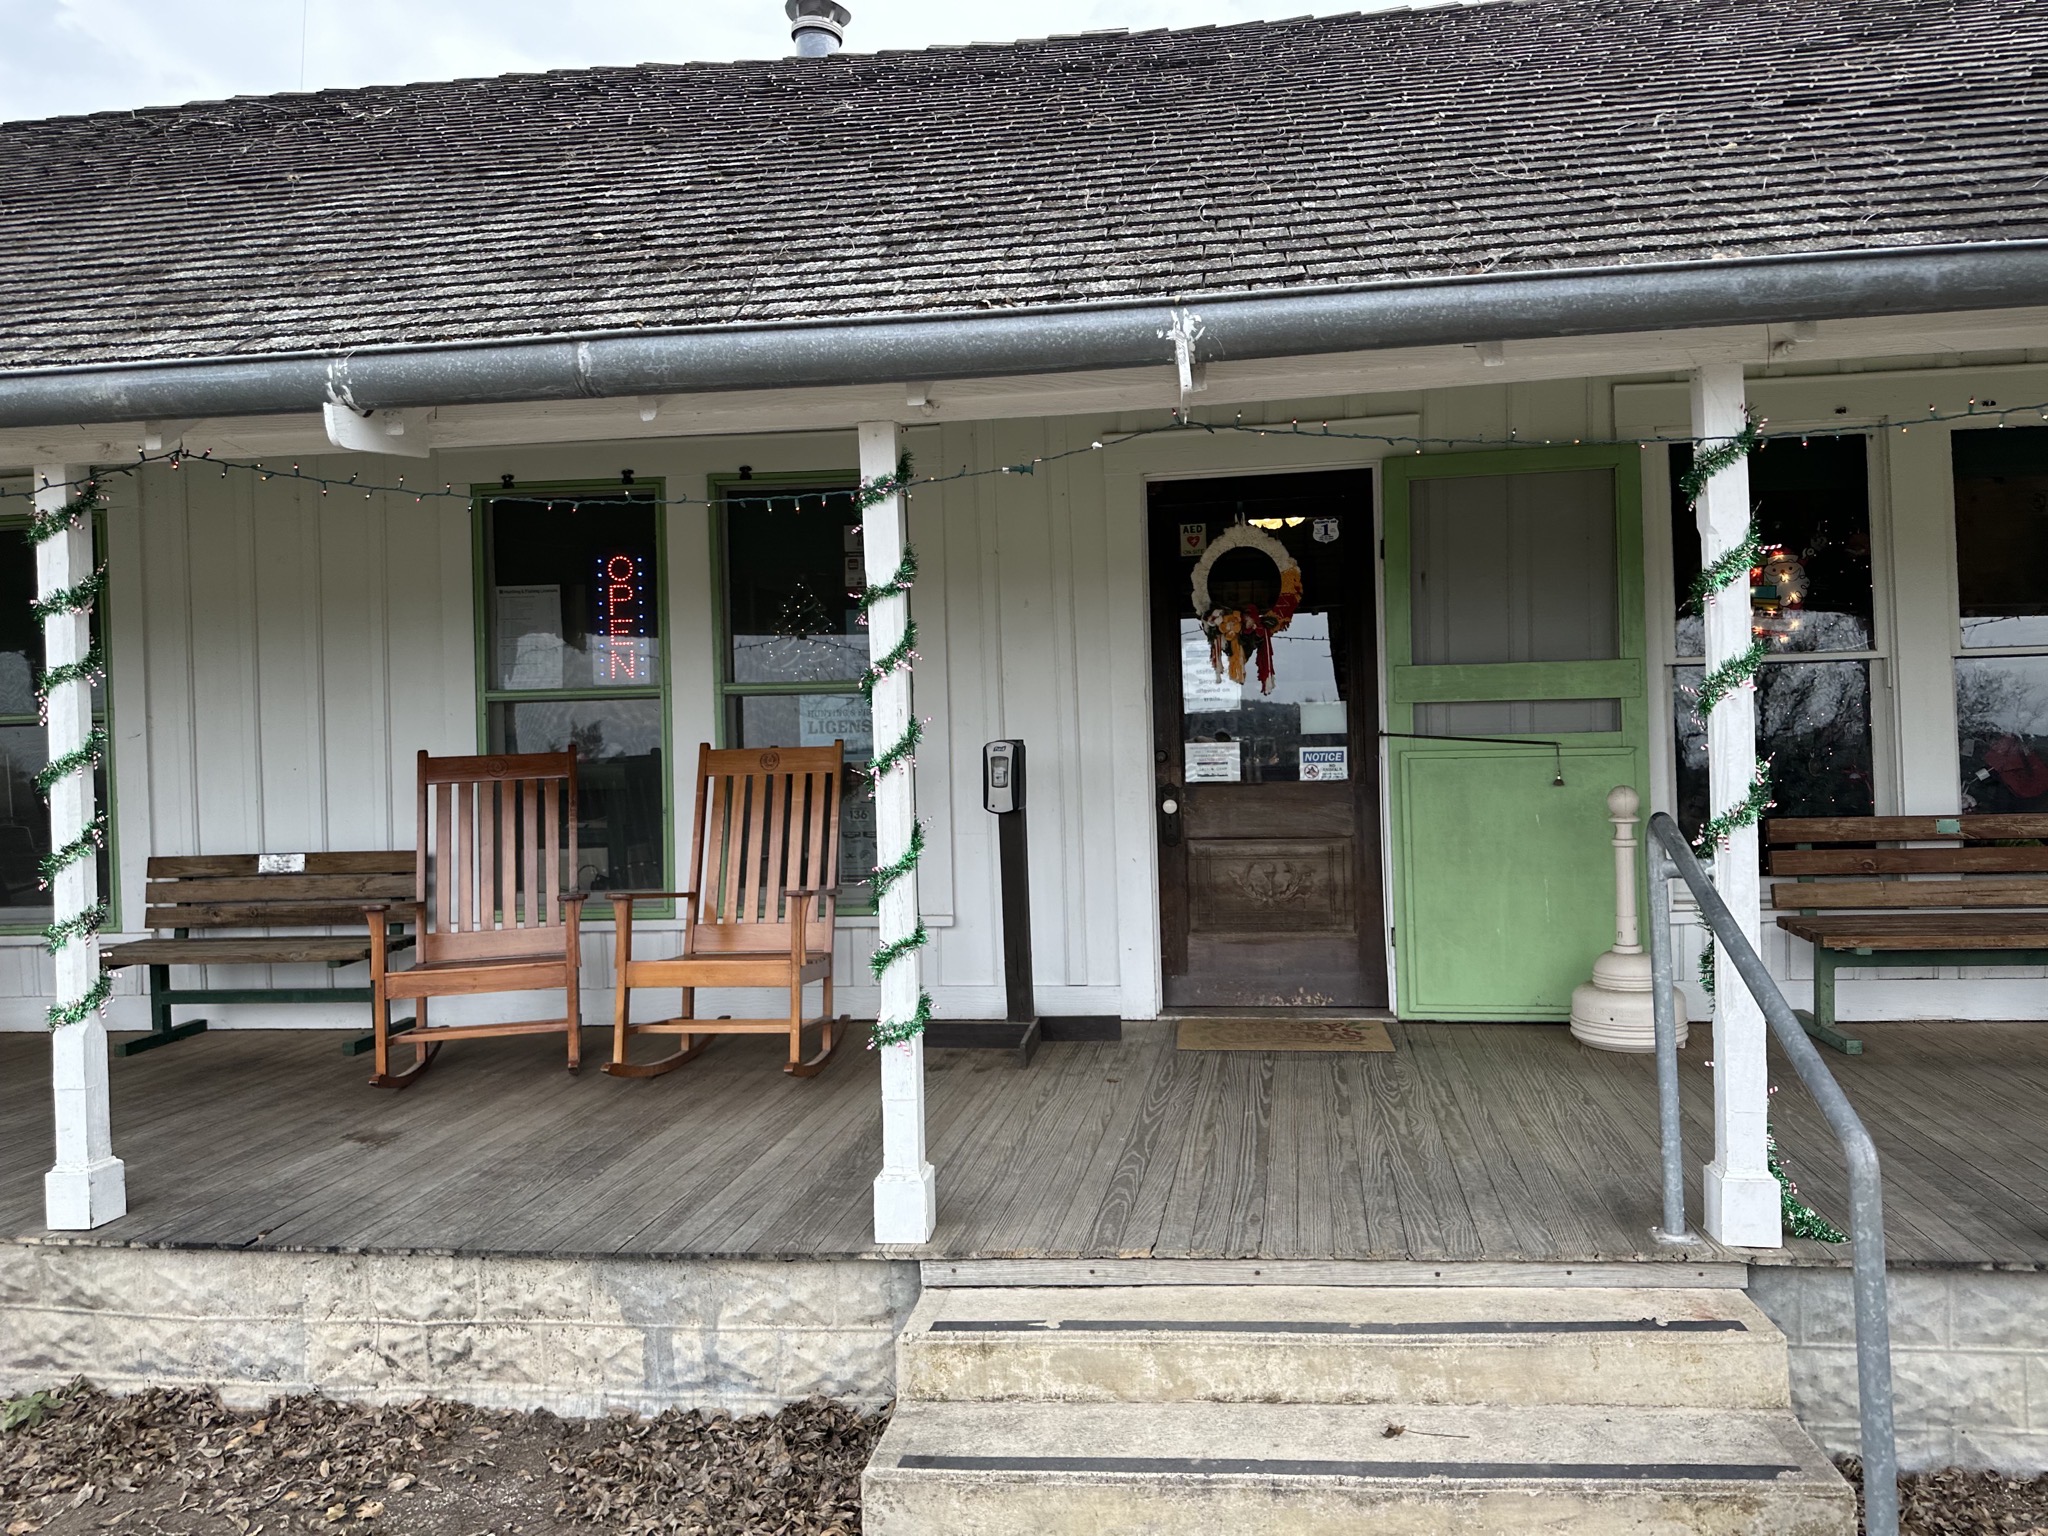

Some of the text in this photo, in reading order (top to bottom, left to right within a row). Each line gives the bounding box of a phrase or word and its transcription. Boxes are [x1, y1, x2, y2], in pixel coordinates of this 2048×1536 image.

[1182, 524, 1203, 534] AED
[1321, 523, 1331, 536] 1
[607, 555, 636, 680] OPEN
[807, 708, 848, 718] HUNTING
[857, 708, 873, 717] FIS
[807, 719, 873, 735] LICENS
[1304, 752, 1343, 762] NOTICE
